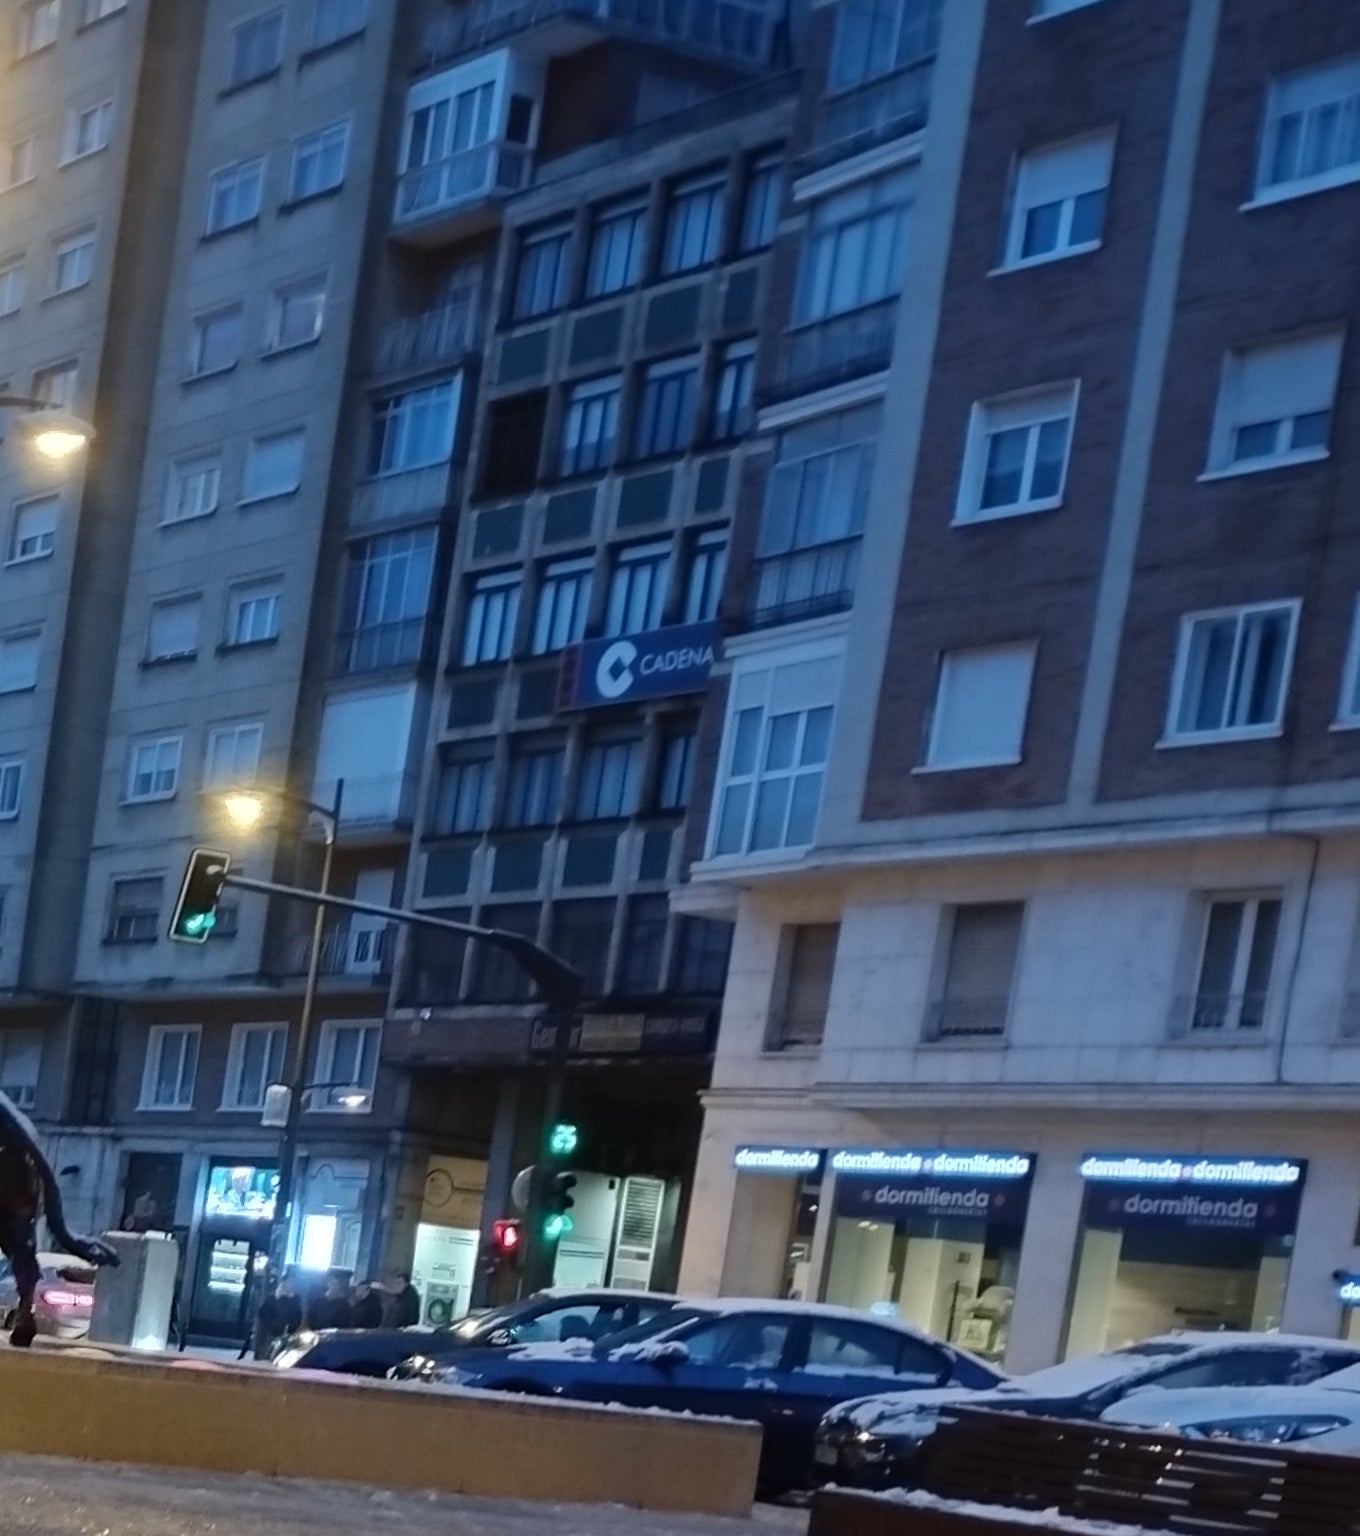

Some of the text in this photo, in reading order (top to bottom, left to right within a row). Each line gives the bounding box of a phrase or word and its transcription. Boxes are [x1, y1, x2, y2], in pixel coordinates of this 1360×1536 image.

[640, 645, 714, 675] CADENA
[735, 1149, 819, 1168] dormitienda
[832, 1151, 1030, 1175] dormitienda dormitienda
[1081, 1157, 1300, 1183] dormitienda dormitienda
[875, 1186, 990, 1208] dormitienda
[1124, 1194, 1259, 1219] dormitienda
